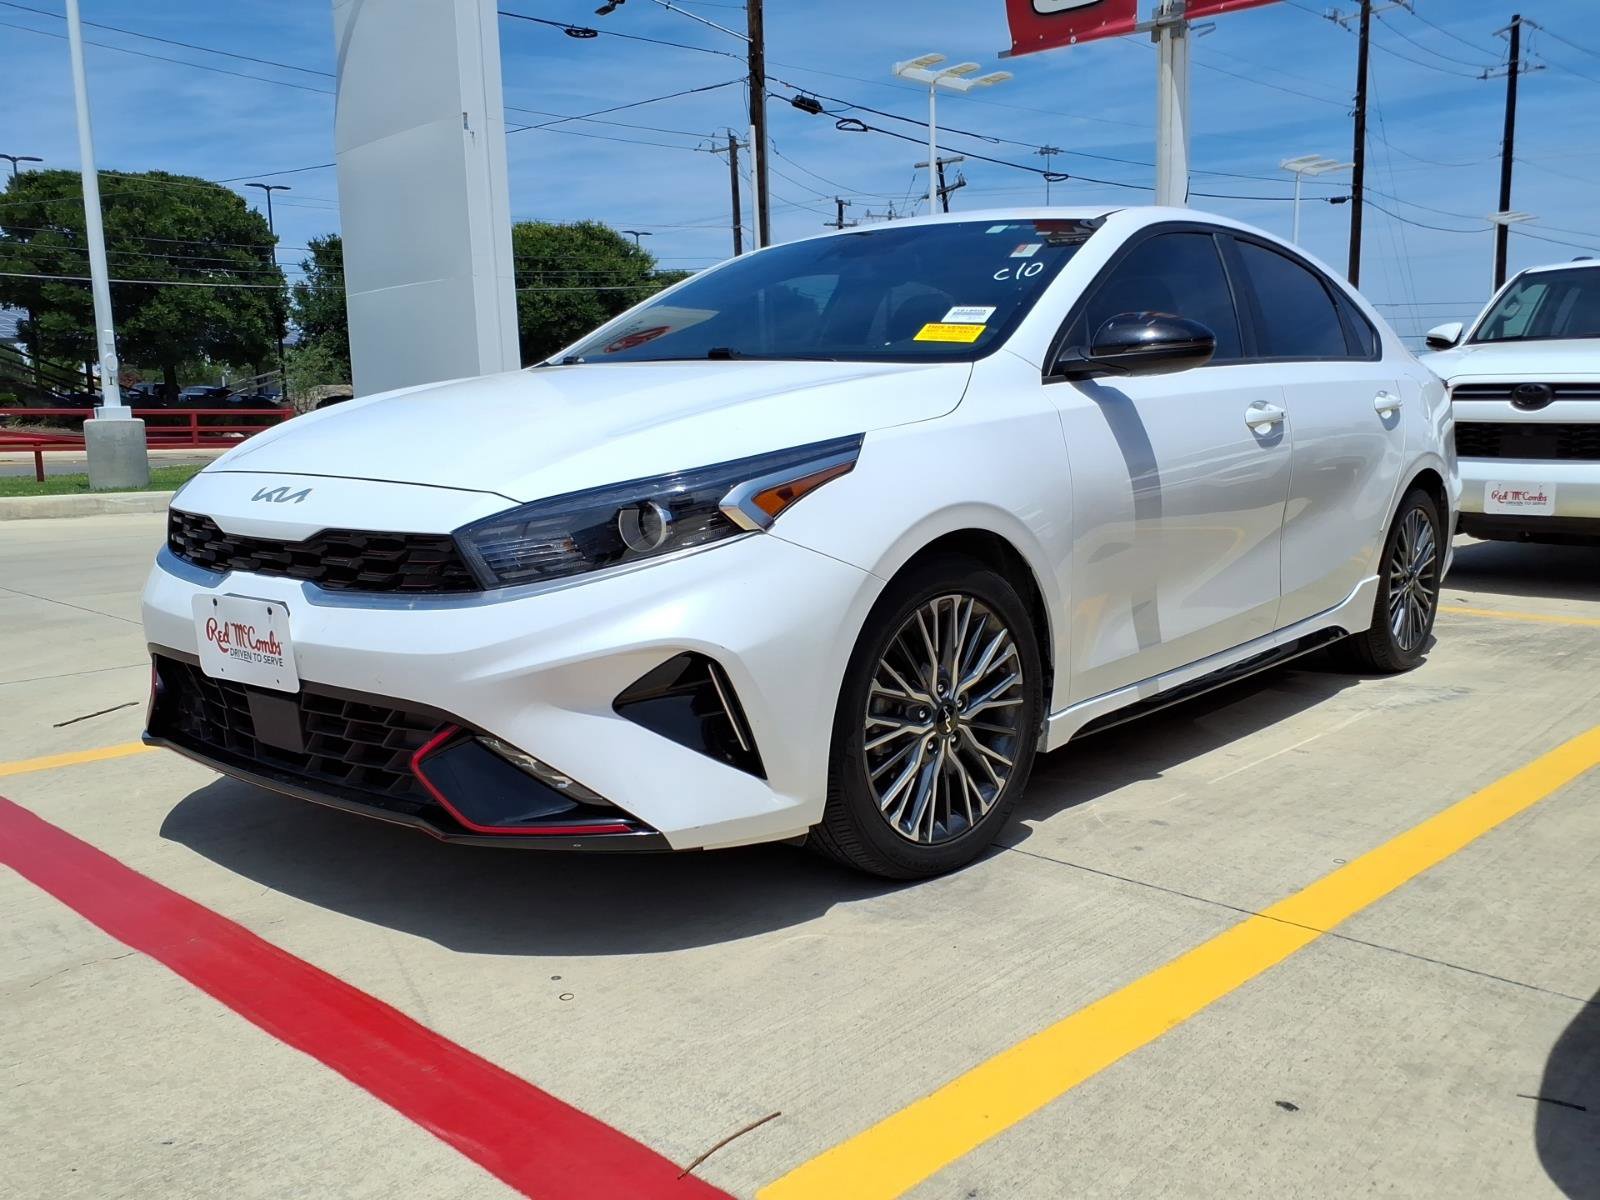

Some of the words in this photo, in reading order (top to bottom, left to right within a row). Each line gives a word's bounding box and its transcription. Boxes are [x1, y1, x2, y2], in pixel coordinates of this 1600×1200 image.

[251, 486, 313, 504] KIA
[1491, 490, 1508, 504] Red
[1510, 491, 1547, 501] McCombs
[206, 617, 231, 654] Red
[231, 622, 282, 656] McCombs
[230, 648, 253, 661] DRIVEN
[253, 651, 262, 663] TO
[263, 655, 284, 667] SERVE
